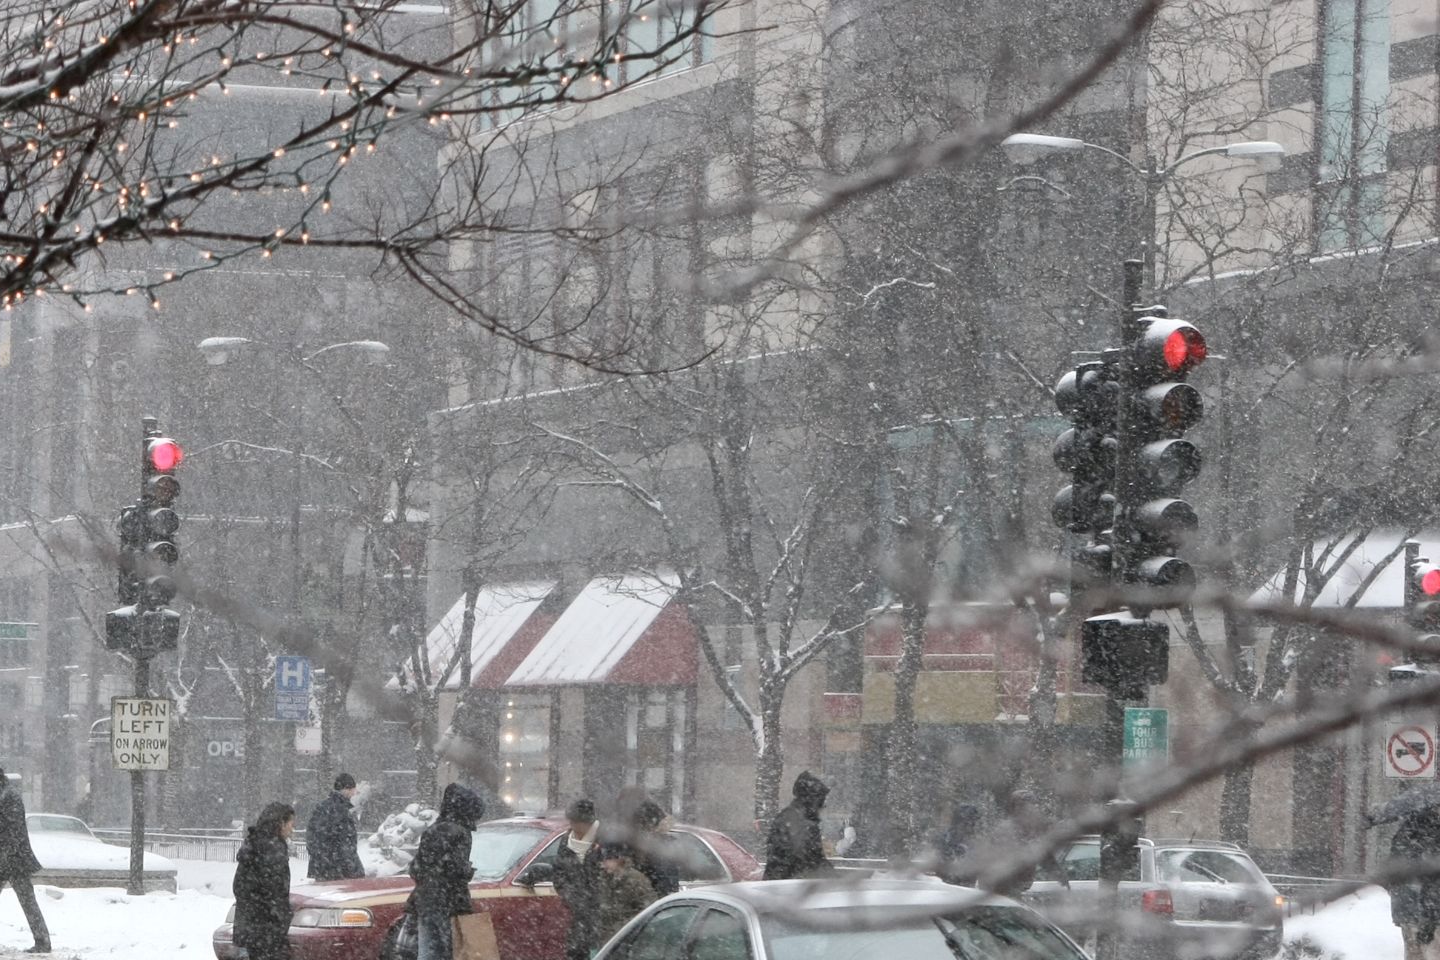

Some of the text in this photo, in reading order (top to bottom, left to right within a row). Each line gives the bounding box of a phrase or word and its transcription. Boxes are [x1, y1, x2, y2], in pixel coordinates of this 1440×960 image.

[282, 661, 304, 687] H
[116, 701, 166, 717] TURN
[120, 720, 165, 733] LEFT
[1132, 727, 1157, 738] TOUR
[115, 738, 168, 750] ON ARROW
[1134, 737, 1153, 748] BUS
[120, 752, 161, 764] ONLY
[1122, 748, 1166, 759] PARKIG
